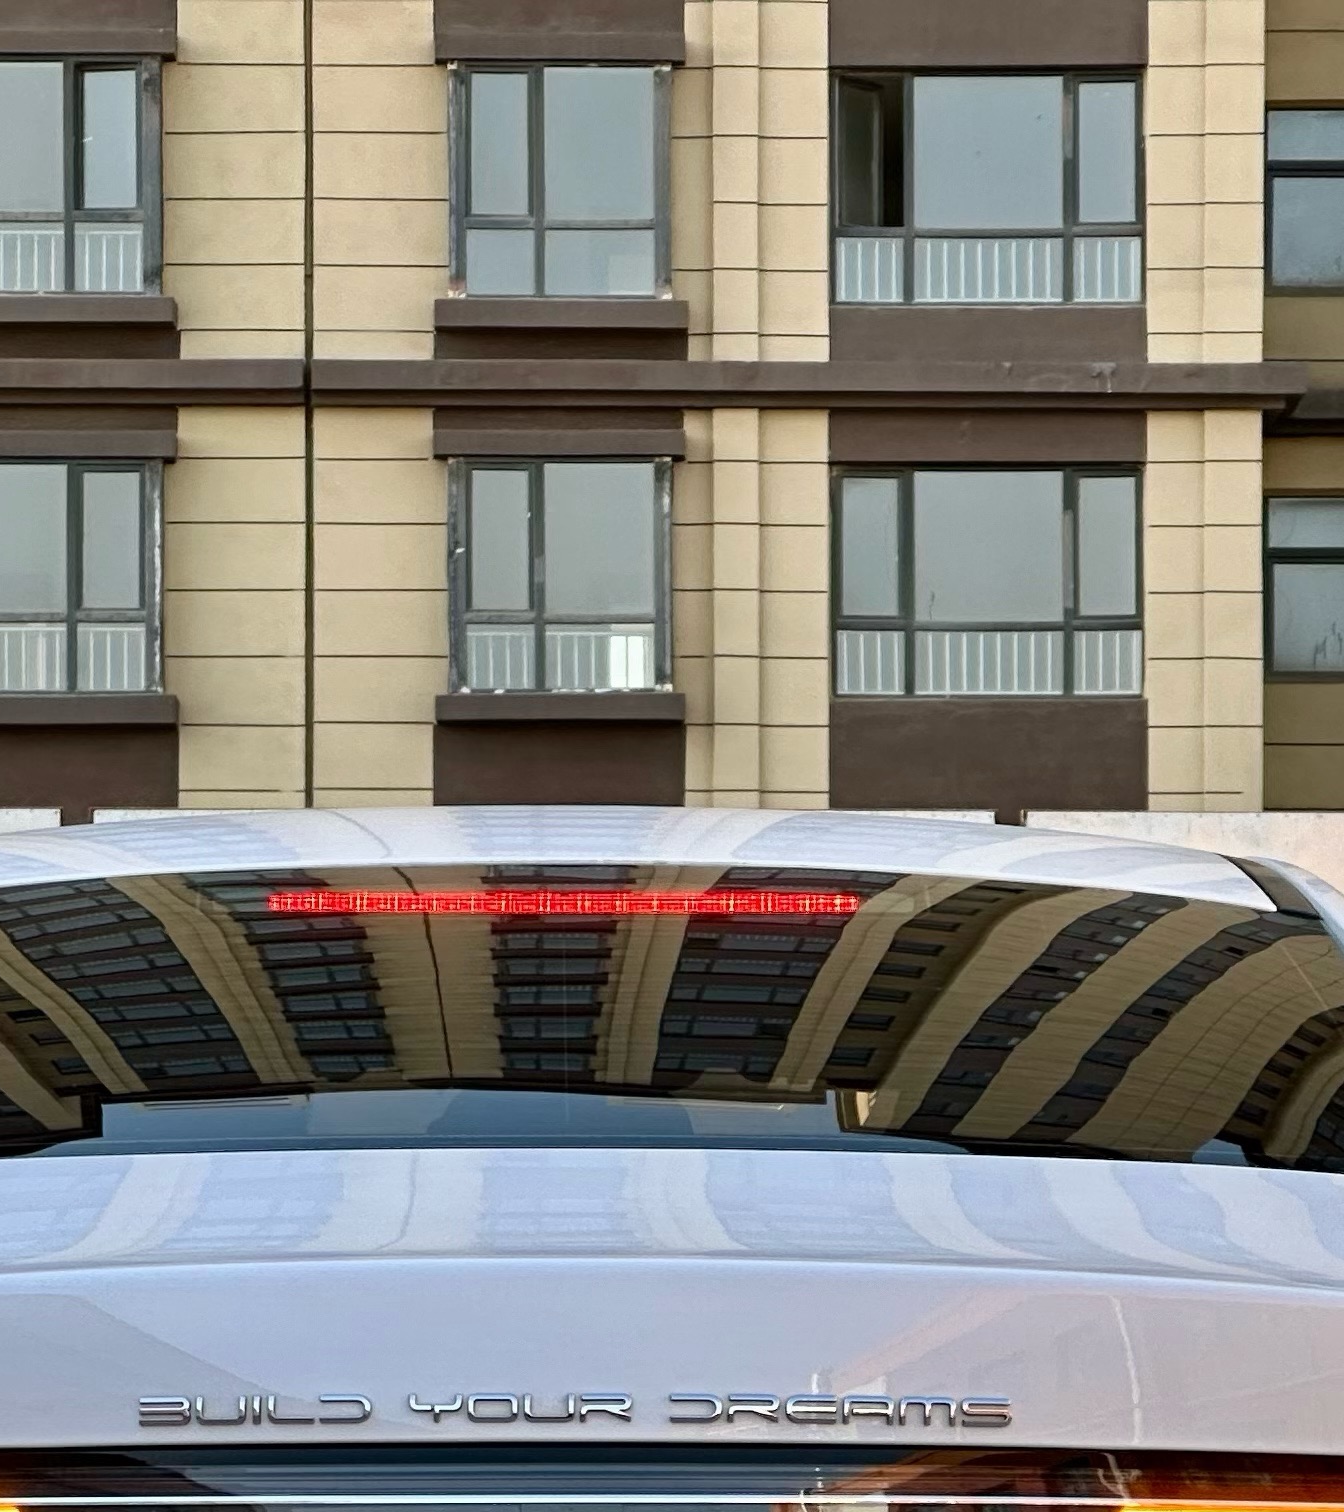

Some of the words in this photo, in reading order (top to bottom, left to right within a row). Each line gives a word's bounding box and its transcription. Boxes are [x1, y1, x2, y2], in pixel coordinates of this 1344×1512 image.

[138, 1393, 372, 1427] BUILD
[408, 1392, 632, 1424] YOUR
[669, 1392, 1013, 1427] DREAMS
